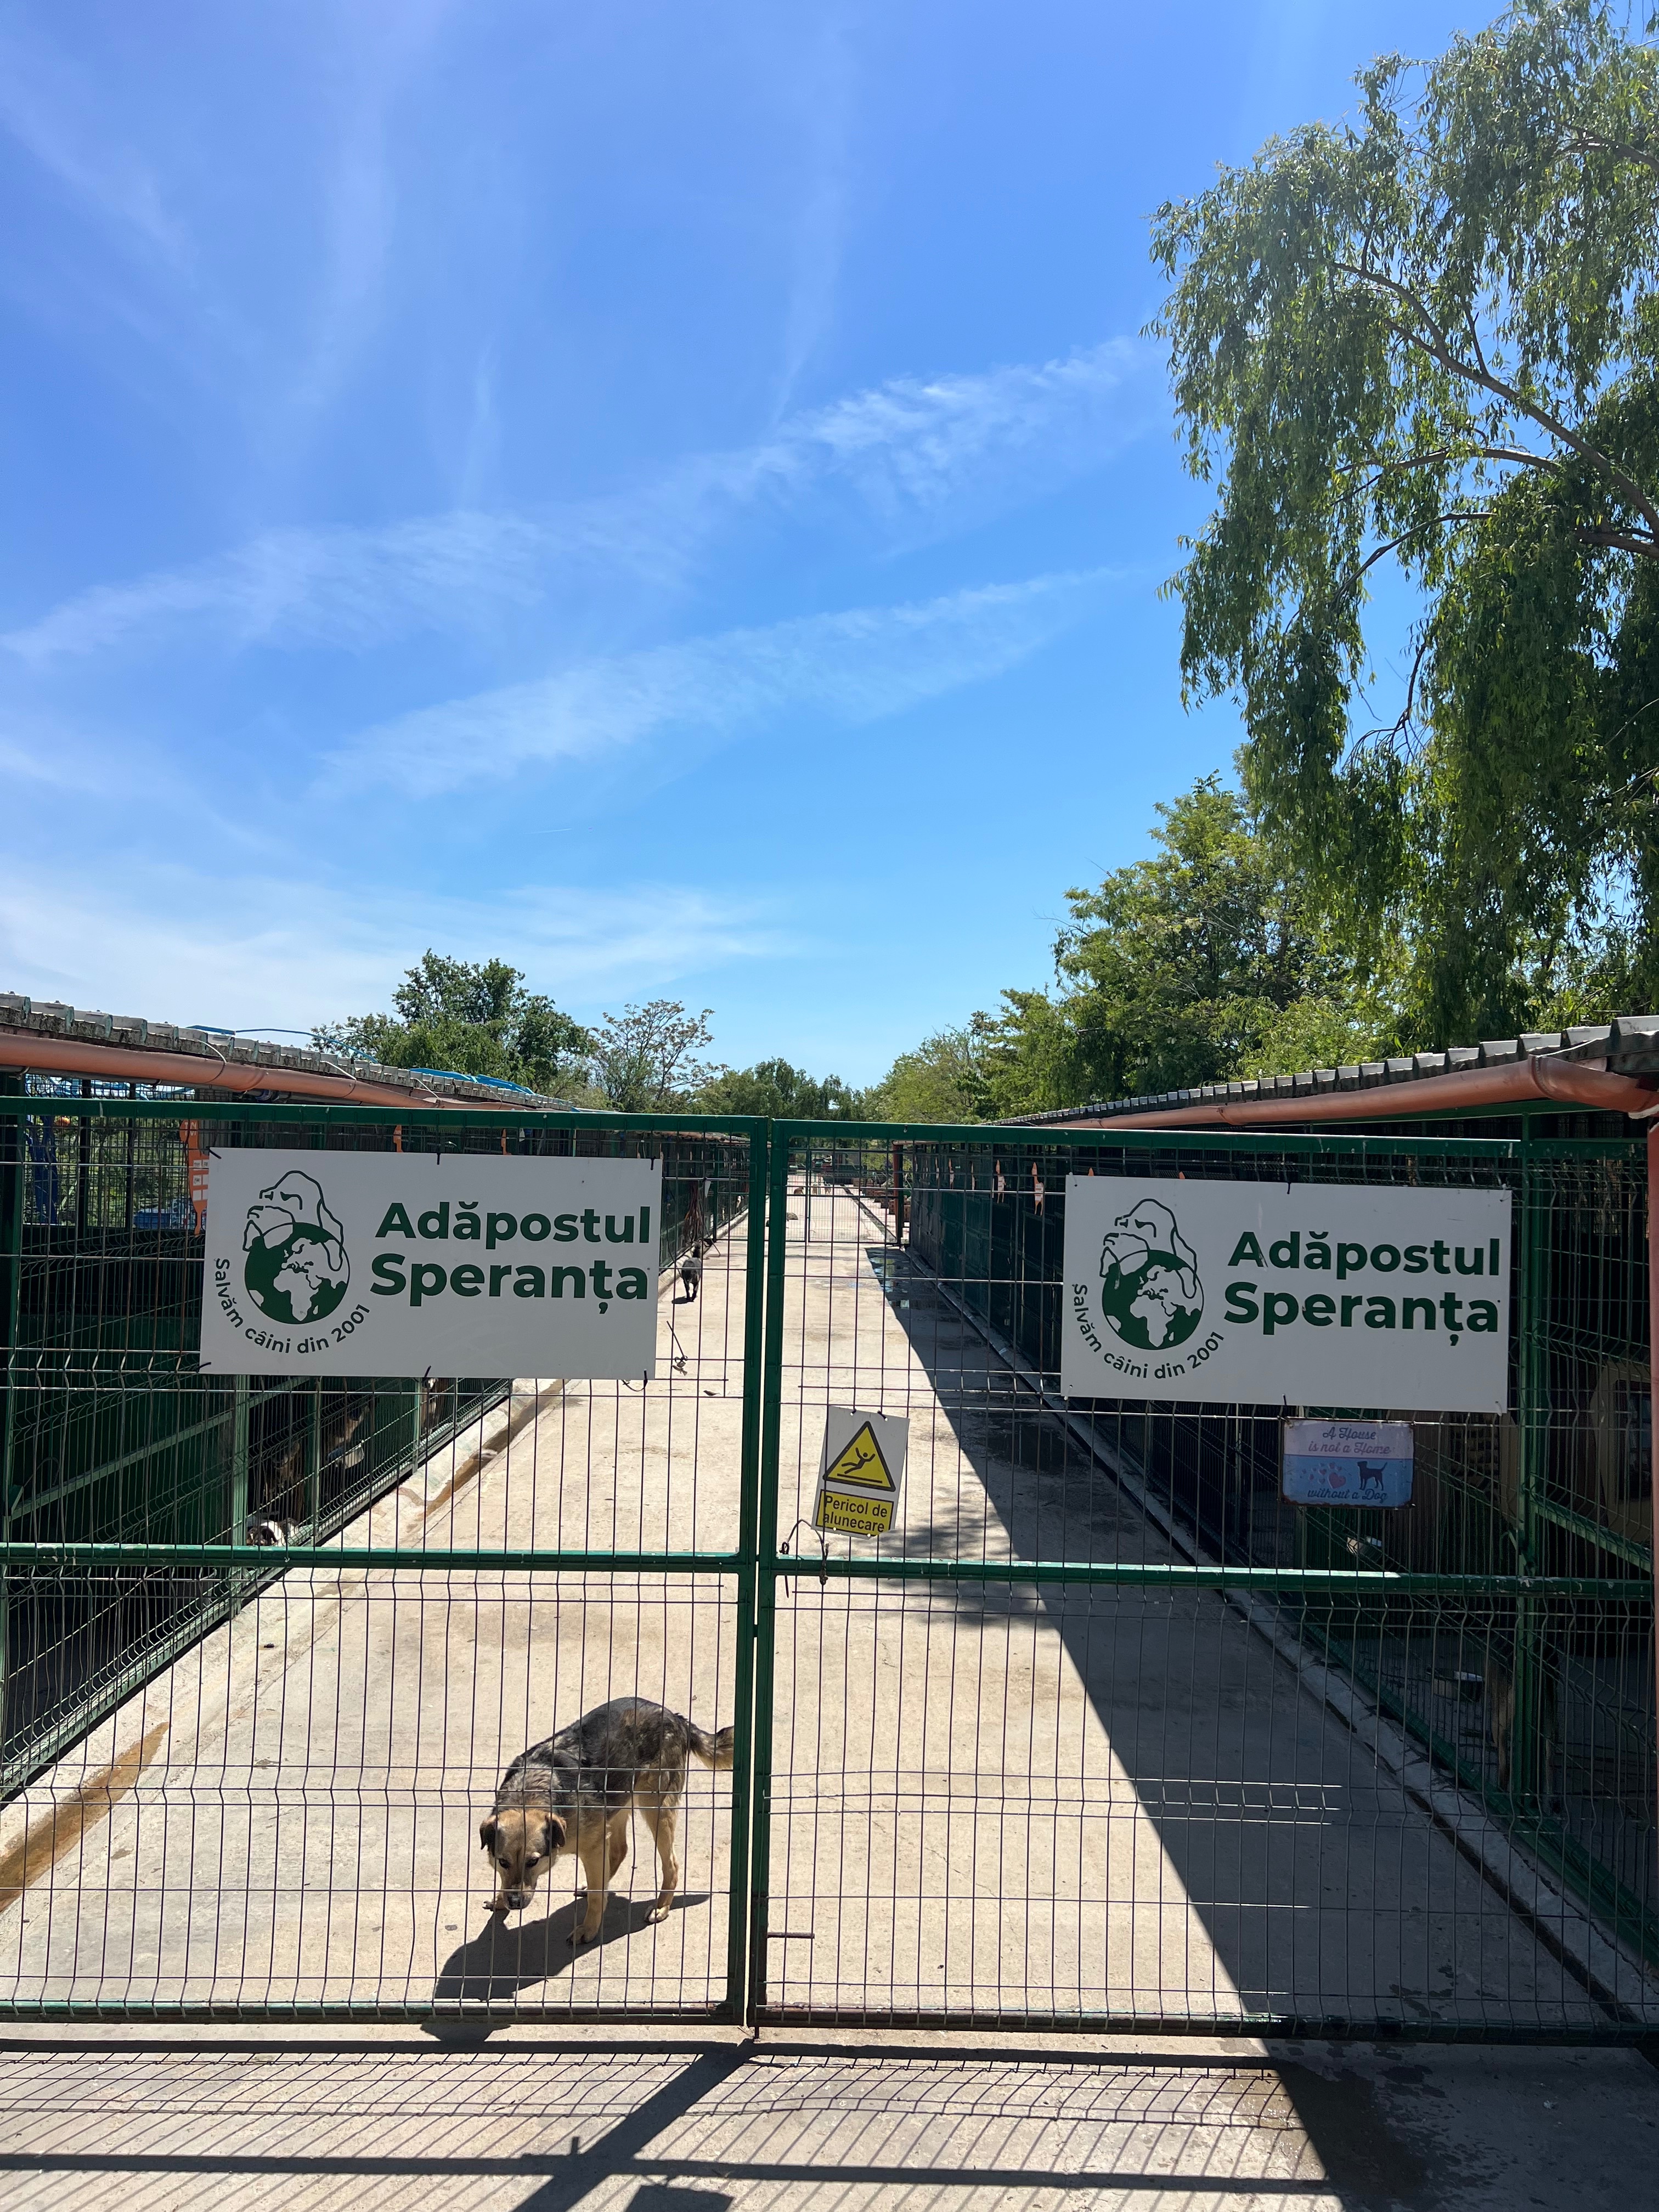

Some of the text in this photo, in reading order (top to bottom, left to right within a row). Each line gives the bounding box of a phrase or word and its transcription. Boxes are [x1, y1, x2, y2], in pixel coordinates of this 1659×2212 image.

[375, 1201, 650, 1249] Adăpostul
[1228, 1231, 1499, 1280] Adăpostul
[215, 1259, 370, 1353] Salvăm câini din 2001
[370, 1254, 649, 1314] Speranța
[1074, 1284, 1224, 1379] Salvăm câini din 2001
[1223, 1282, 1498, 1346] Speranța
[1308, 1441, 1391, 1454] is not a Home
[1323, 1427, 1376, 1440] A House
[825, 1496, 887, 1517] Pericol de
[1307, 1488, 1350, 1499] without
[1362, 1489, 1387, 1504] Dog
[824, 1512, 884, 1532] alunecare
